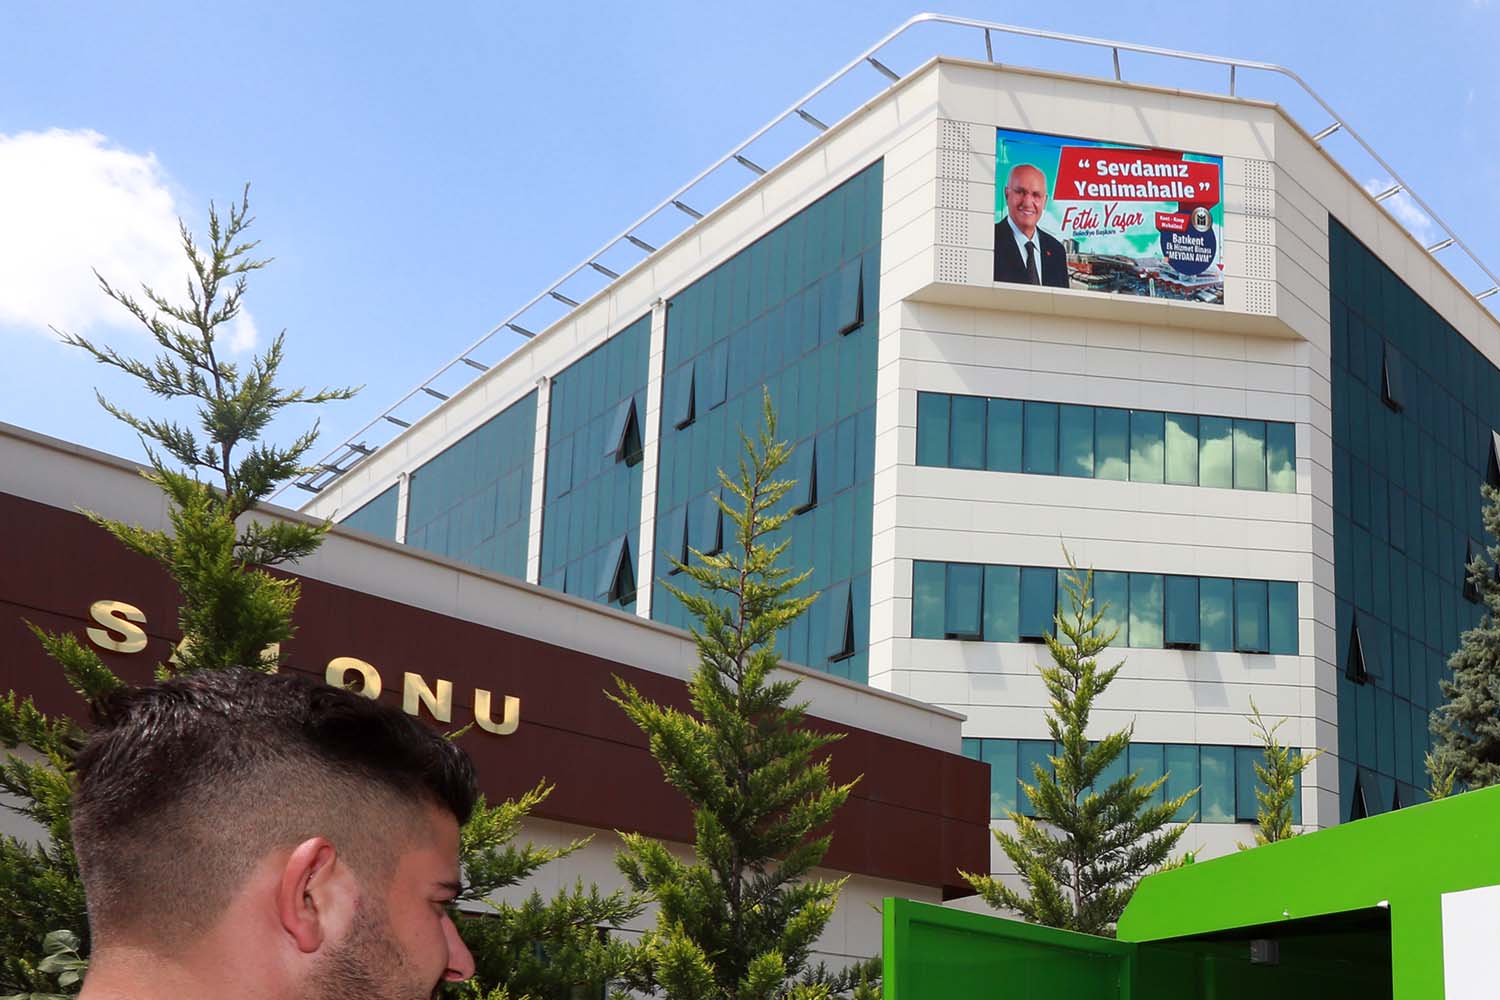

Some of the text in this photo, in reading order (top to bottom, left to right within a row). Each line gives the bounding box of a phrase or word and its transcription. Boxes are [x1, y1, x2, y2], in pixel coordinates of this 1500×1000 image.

[1096, 159, 1189, 177] Sevdamız
[1074, 179, 1195, 198] Yenimahalle
[1061, 202, 1144, 232] Fethi Yaşar
[1172, 233, 1204, 246] Batıkent
